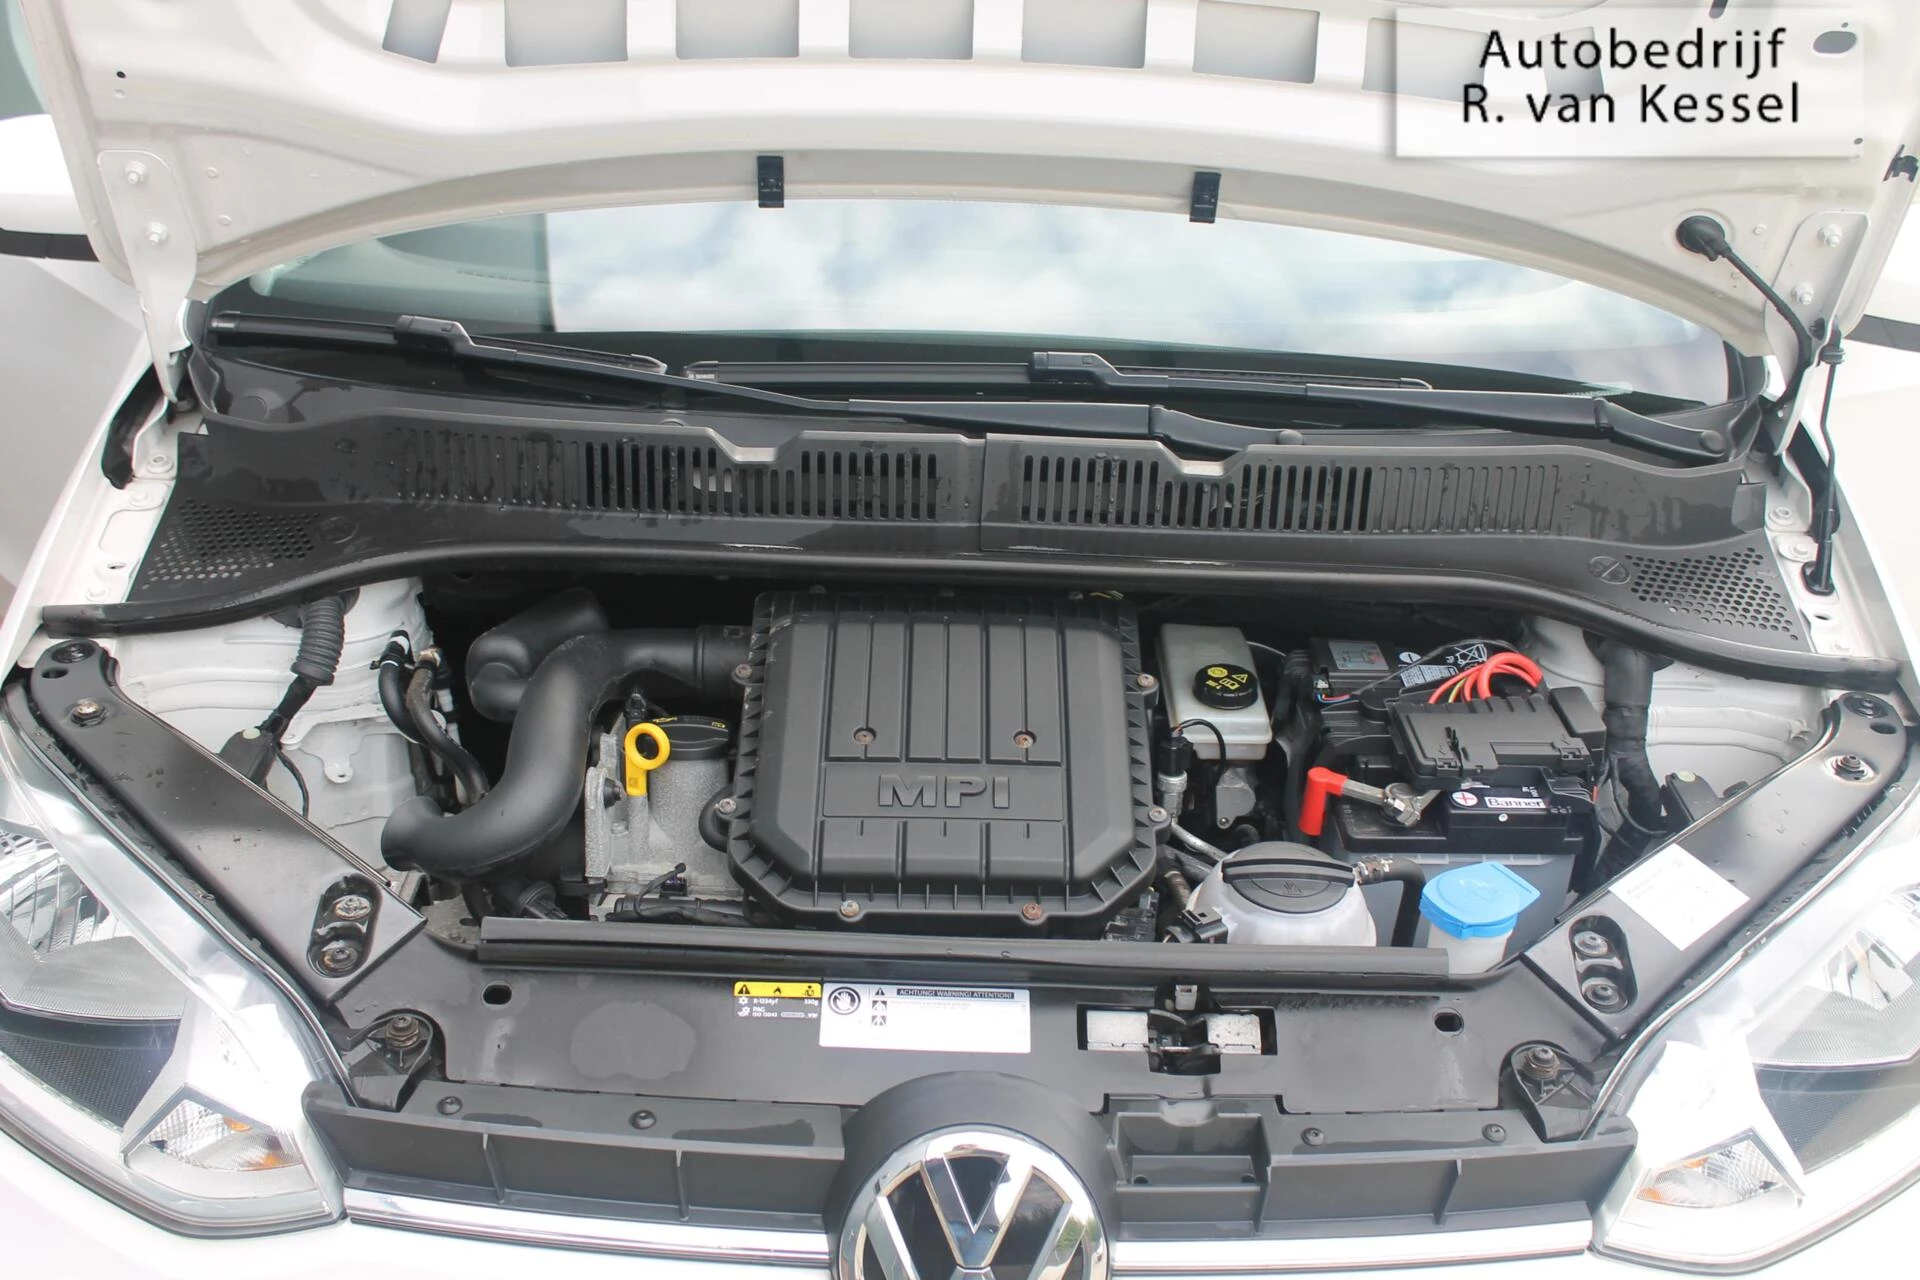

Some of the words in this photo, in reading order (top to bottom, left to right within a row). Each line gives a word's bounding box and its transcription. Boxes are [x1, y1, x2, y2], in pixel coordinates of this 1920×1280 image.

[878, 774, 1010, 809] MPI
[1488, 798, 1542, 807] Banner
[899, 989, 935, 997] ACHTUNG!
[936, 990, 972, 998] WARNING!
